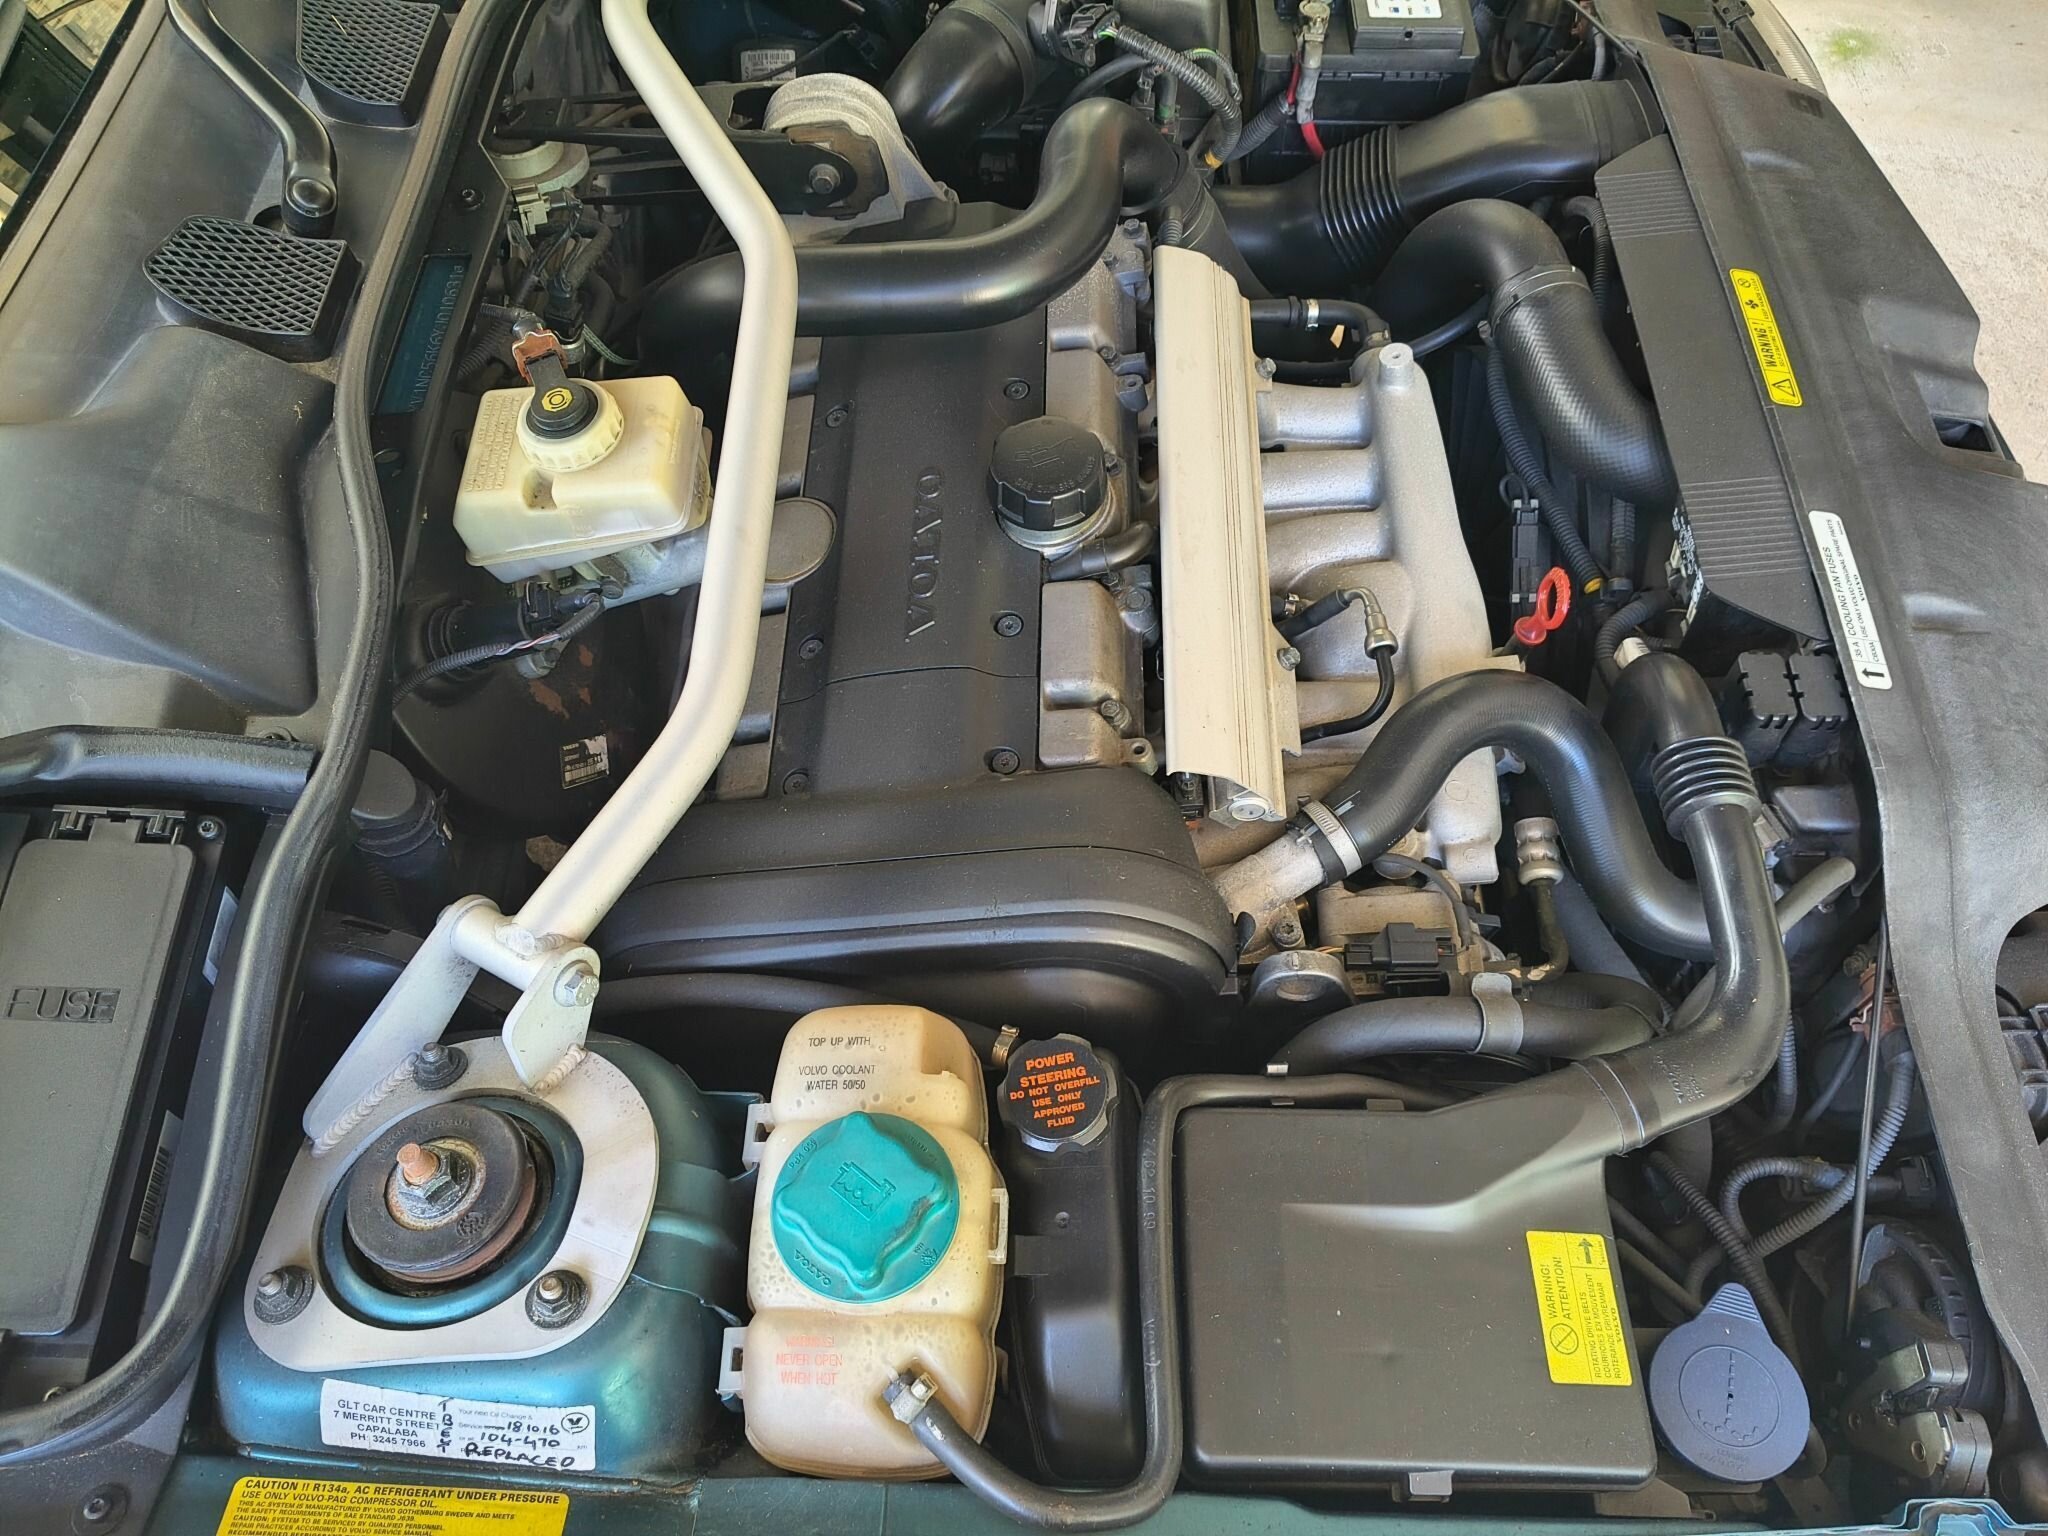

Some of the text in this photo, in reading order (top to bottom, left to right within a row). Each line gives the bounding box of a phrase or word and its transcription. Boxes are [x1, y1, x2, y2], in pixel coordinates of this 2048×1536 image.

[1753, 328, 1778, 368] WARNING
[1826, 519, 1838, 538] PARTS
[905, 474, 943, 644] VOLVO
[1822, 546, 1856, 636] COOLING FAN FUSES
[1853, 574, 1865, 602] VOLVO
[6, 988, 120, 1022] FUSE
[808, 1036, 871, 1047] TOP UP WITH
[799, 1064, 876, 1075] VOLVO COOLANT
[1025, 1051, 1075, 1071] POWER
[806, 1079, 866, 1090] WATER 50/50
[1020, 1066, 1086, 1088] STEERING
[1009, 1075, 1100, 1100] DO NOT OVERFILL
[1031, 1091, 1082, 1108] USE ONLY
[1033, 1102, 1086, 1119] APPROVED
[1046, 1115, 1075, 1128] FLUID
[793, 1248, 832, 1287] VOLVO
[1540, 1264, 1557, 1318] WARNING!
[1553, 1257, 1572, 1320] ATTENTION!
[1596, 1323, 1603, 1332] EN
[1611, 1308, 1622, 1342] VOLVO
[1580, 1292, 1601, 1378] ROTATING DRIVE BELTS
[776, 1352, 843, 1367] NEVER OPEN
[780, 1371, 840, 1386] WHEN HOT
[337, 1399, 437, 1420] GLT CAR CENTRE
[501, 1411, 527, 1420] Change
[333, 1410, 440, 1430] 7 MERRITT STREET
[458, 1422, 482, 1430] Service
[507, 1420, 523, 1433] 18
[526, 1424, 540, 1432] 10
[543, 1424, 560, 1435] 16
[357, 1423, 418, 1437] CAPALABA
[372, 1435, 398, 1445] 3245
[401, 1438, 426, 1447] 7966
[465, 1441, 575, 1468] REPLACED
[242, 1490, 438, 1508] USE ONLY VOLVO-PAG COMPRESSOR OIL.
[246, 1479, 298, 1490] CAUTION
[312, 1483, 350, 1494] R134a,
[354, 1485, 372, 1495] AC
[374, 1487, 454, 1499] REFRIGERANT
[456, 1492, 497, 1501] UNDER
[500, 1493, 560, 1504] PRESSURE
[278, 1509, 331, 1518] REQUIREMENTS
[305, 1504, 361, 1512] MANUFACTURED
